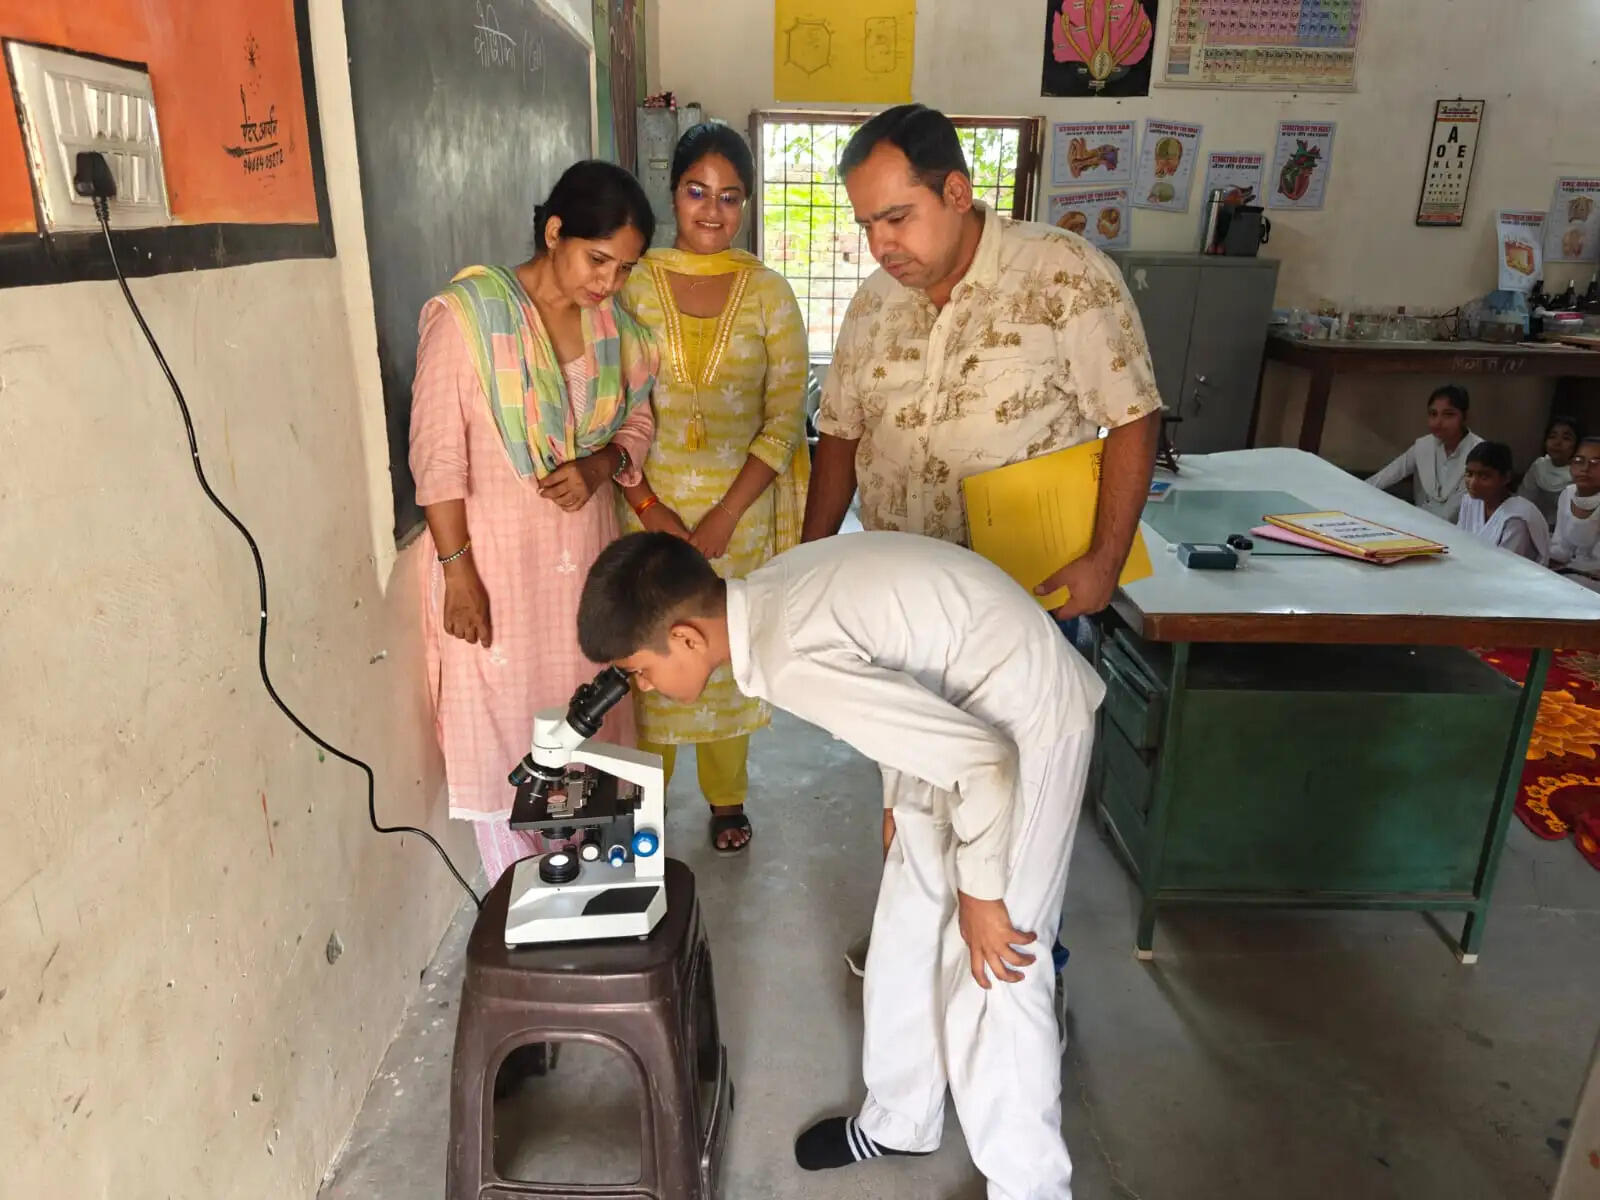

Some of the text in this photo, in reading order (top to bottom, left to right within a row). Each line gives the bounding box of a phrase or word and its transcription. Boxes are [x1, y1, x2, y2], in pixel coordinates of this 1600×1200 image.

[1447, 126, 1458, 143] A
[1436, 144, 1467, 158] O E
